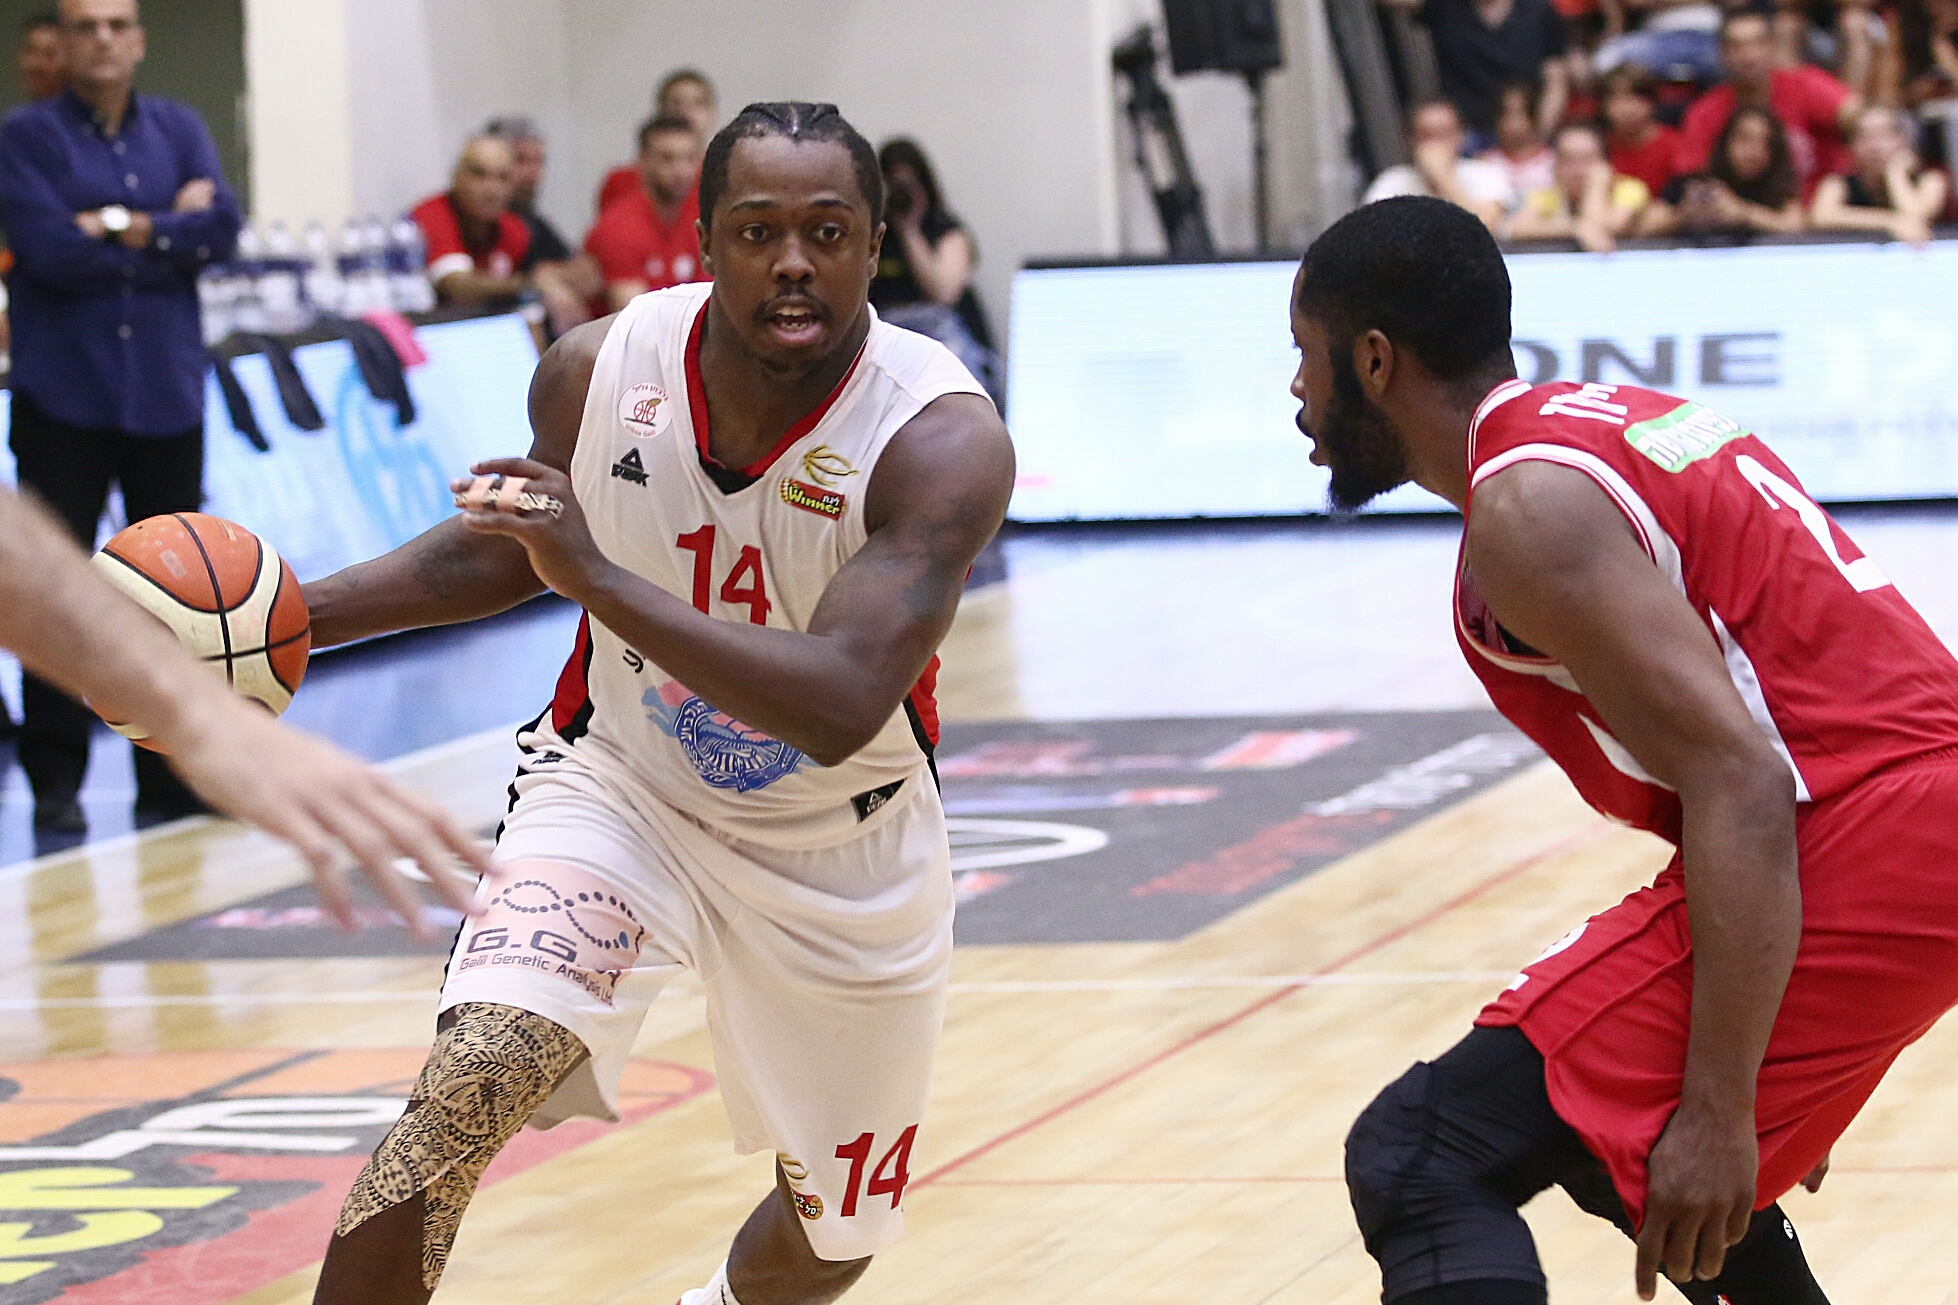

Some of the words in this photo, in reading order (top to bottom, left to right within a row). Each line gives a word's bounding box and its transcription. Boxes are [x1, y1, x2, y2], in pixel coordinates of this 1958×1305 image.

[787, 484, 840, 515] Winner
[676, 524, 772, 626] 14
[460, 954, 488, 971] Galil
[491, 953, 551, 971] Genetic
[835, 1122, 919, 1218] 14
